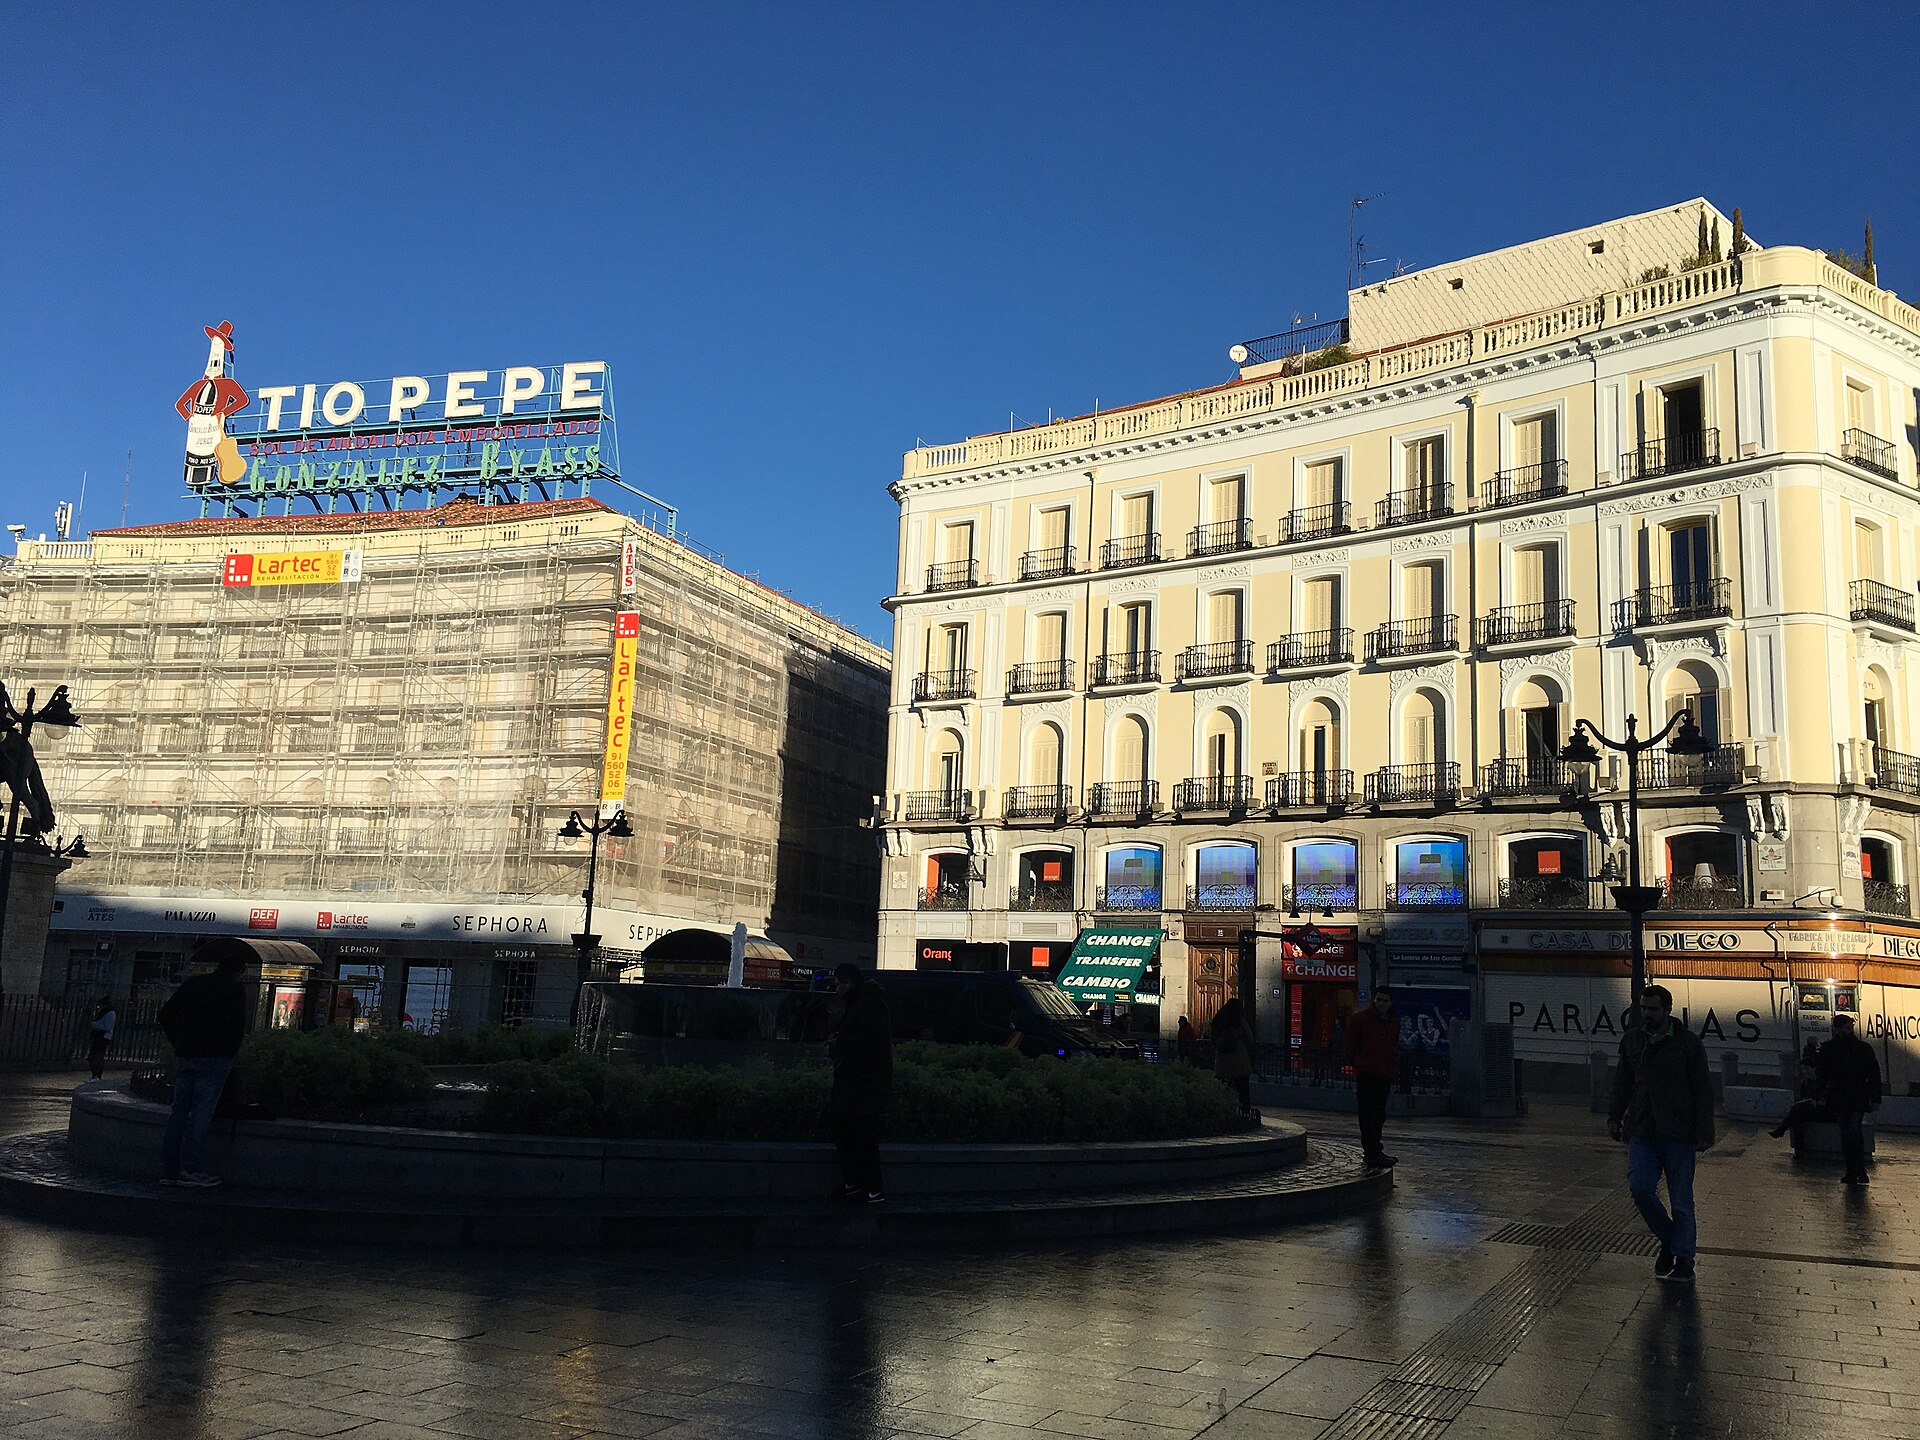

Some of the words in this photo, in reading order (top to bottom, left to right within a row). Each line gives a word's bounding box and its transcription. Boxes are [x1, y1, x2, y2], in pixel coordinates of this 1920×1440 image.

[258, 381, 365, 431] TIO
[389, 361, 605, 423] PEPE
[249, 441, 287, 457] SOL
[294, 438, 319, 453] DE
[327, 430, 436, 451] ANDALUCIA
[445, 419, 598, 443] EMBOTELLADO
[250, 455, 442, 494] GONZALEZ
[480, 442, 600, 480] BYASS
[257, 556, 321, 574] Lartec
[625, 543, 634, 587] ATES
[613, 642, 630, 747] Lartec
[87, 913, 114, 921] ATES
[164, 911, 216, 922] PALAZZO
[251, 909, 277, 919] DEFI
[333, 913, 368, 924] Lartec
[452, 915, 548, 933] SEPHORA
[629, 924, 673, 942] SEPH
[1086, 934, 1154, 947] CHANGE
[1528, 931, 1593, 949] CASA
[1655, 932, 1741, 951] DIEGO
[922, 947, 952, 961] Orang
[1810, 943, 1857, 953] ABANICOS
[1075, 956, 1142, 967] TRANSFER
[1295, 965, 1356, 977] CHANGE
[1062, 976, 1131, 989] CAMBIO
[1134, 993, 1160, 1004] CHANGE
[1509, 1001, 1761, 1043] PARAAS
